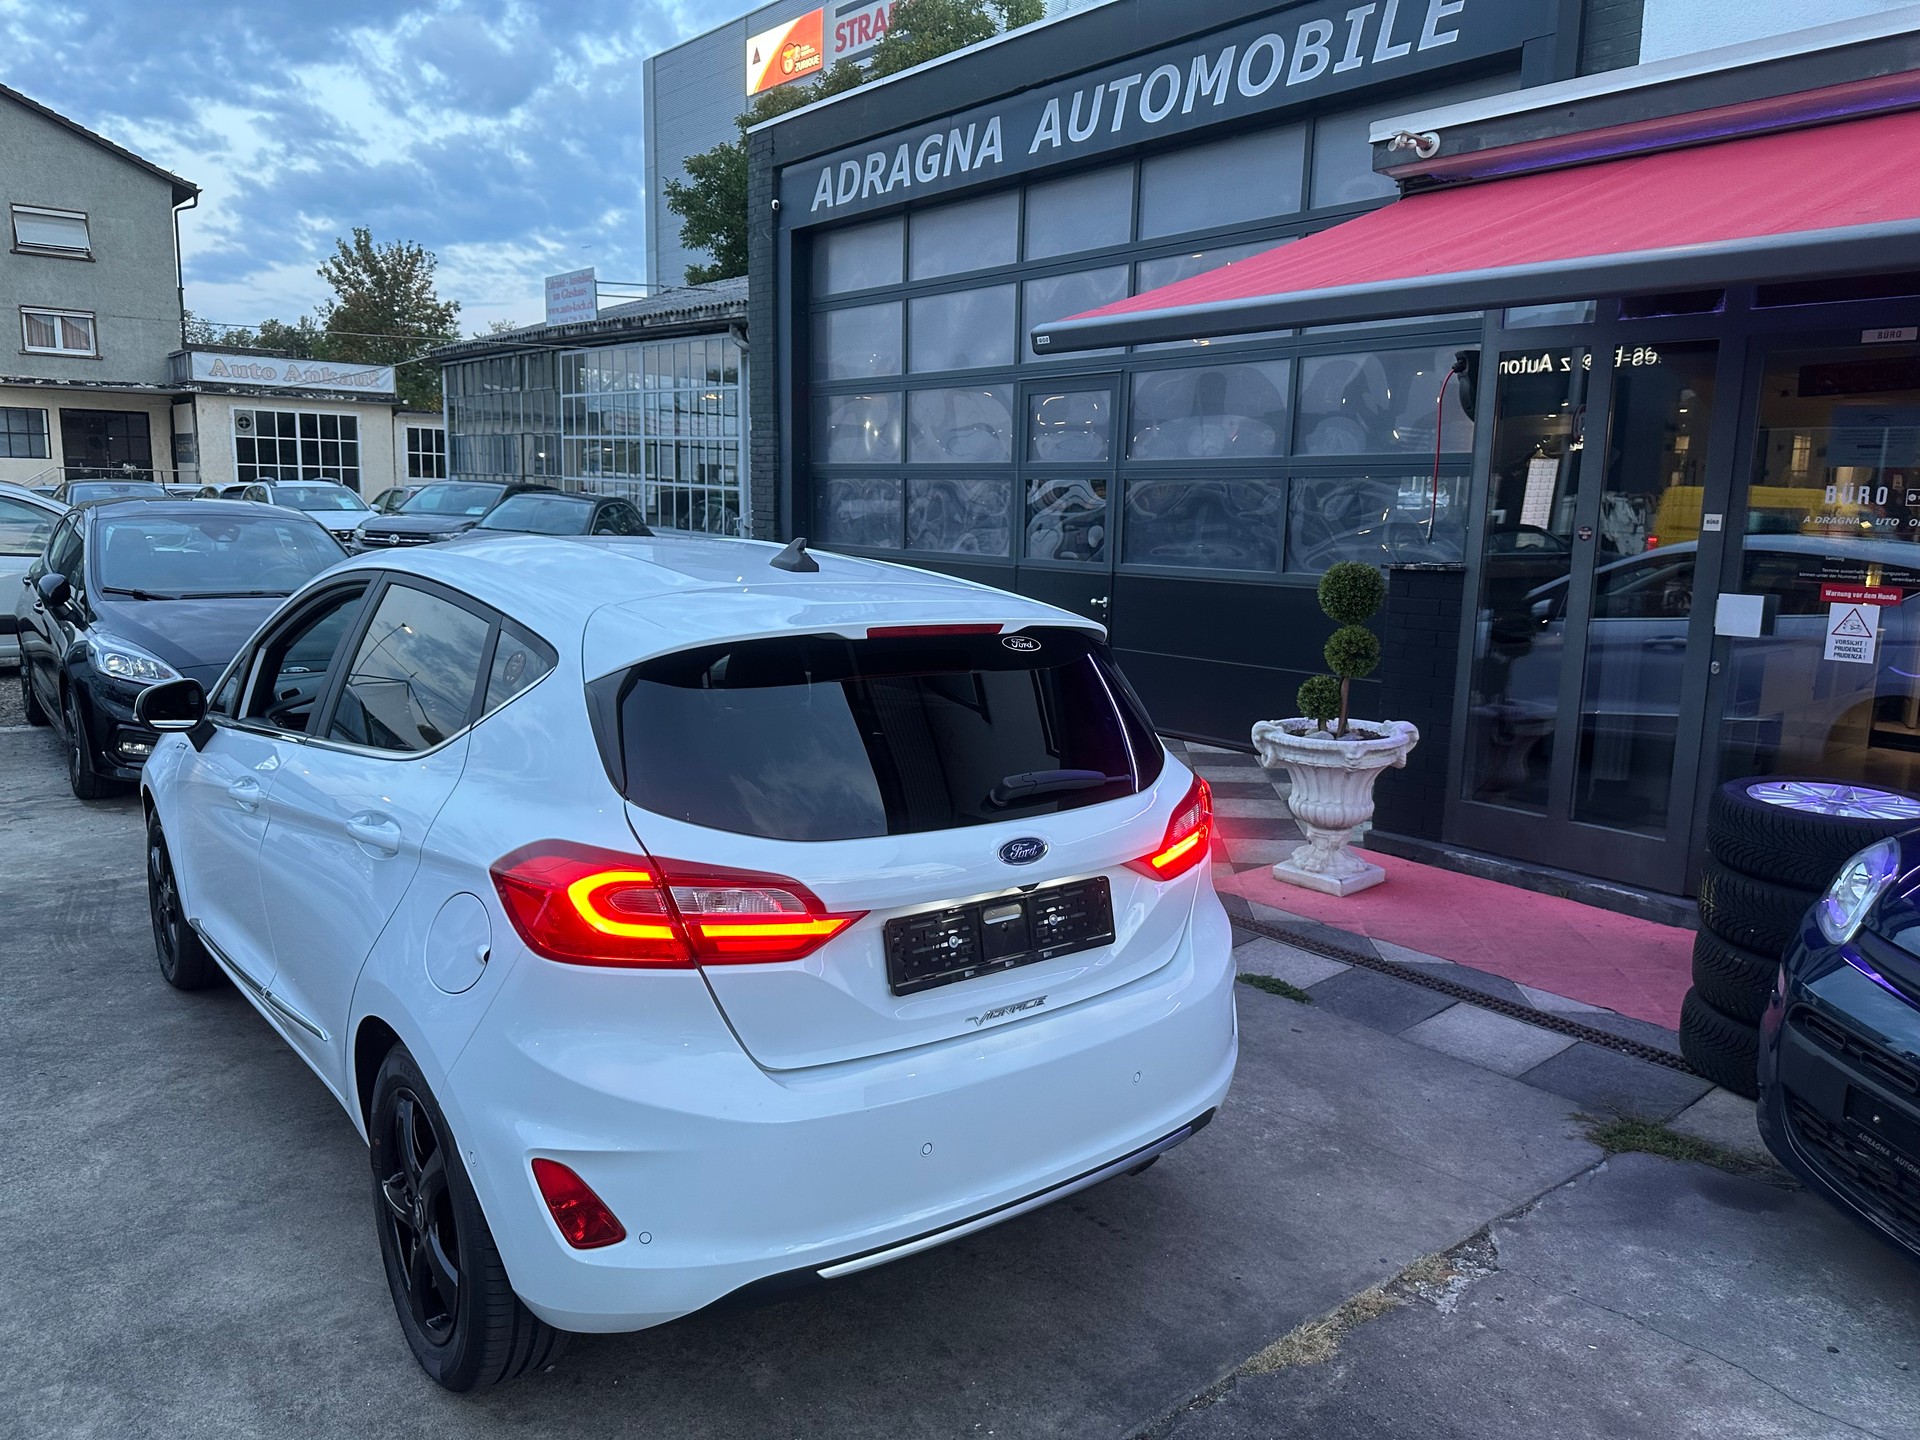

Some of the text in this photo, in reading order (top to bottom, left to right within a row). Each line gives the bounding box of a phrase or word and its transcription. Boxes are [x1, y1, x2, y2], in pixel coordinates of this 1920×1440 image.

[811, 0, 1465, 212] ADRAGNA AUTOMOBILE
[1878, 330, 1902, 340] BÜRO
[209, 358, 381, 388] Auto Ankauf
[1824, 482, 1889, 506] BÜRO
[1825, 589, 1852, 599] Warnung
[1877, 592, 1897, 601] Hunde
[1010, 637, 1034, 649] Ford
[1834, 645, 1863, 653] PRUDENCE
[1833, 652, 1862, 660] PRUDENZA
[1010, 841, 1038, 859] Ford
[1857, 1132, 1891, 1157] ADRAGNA
